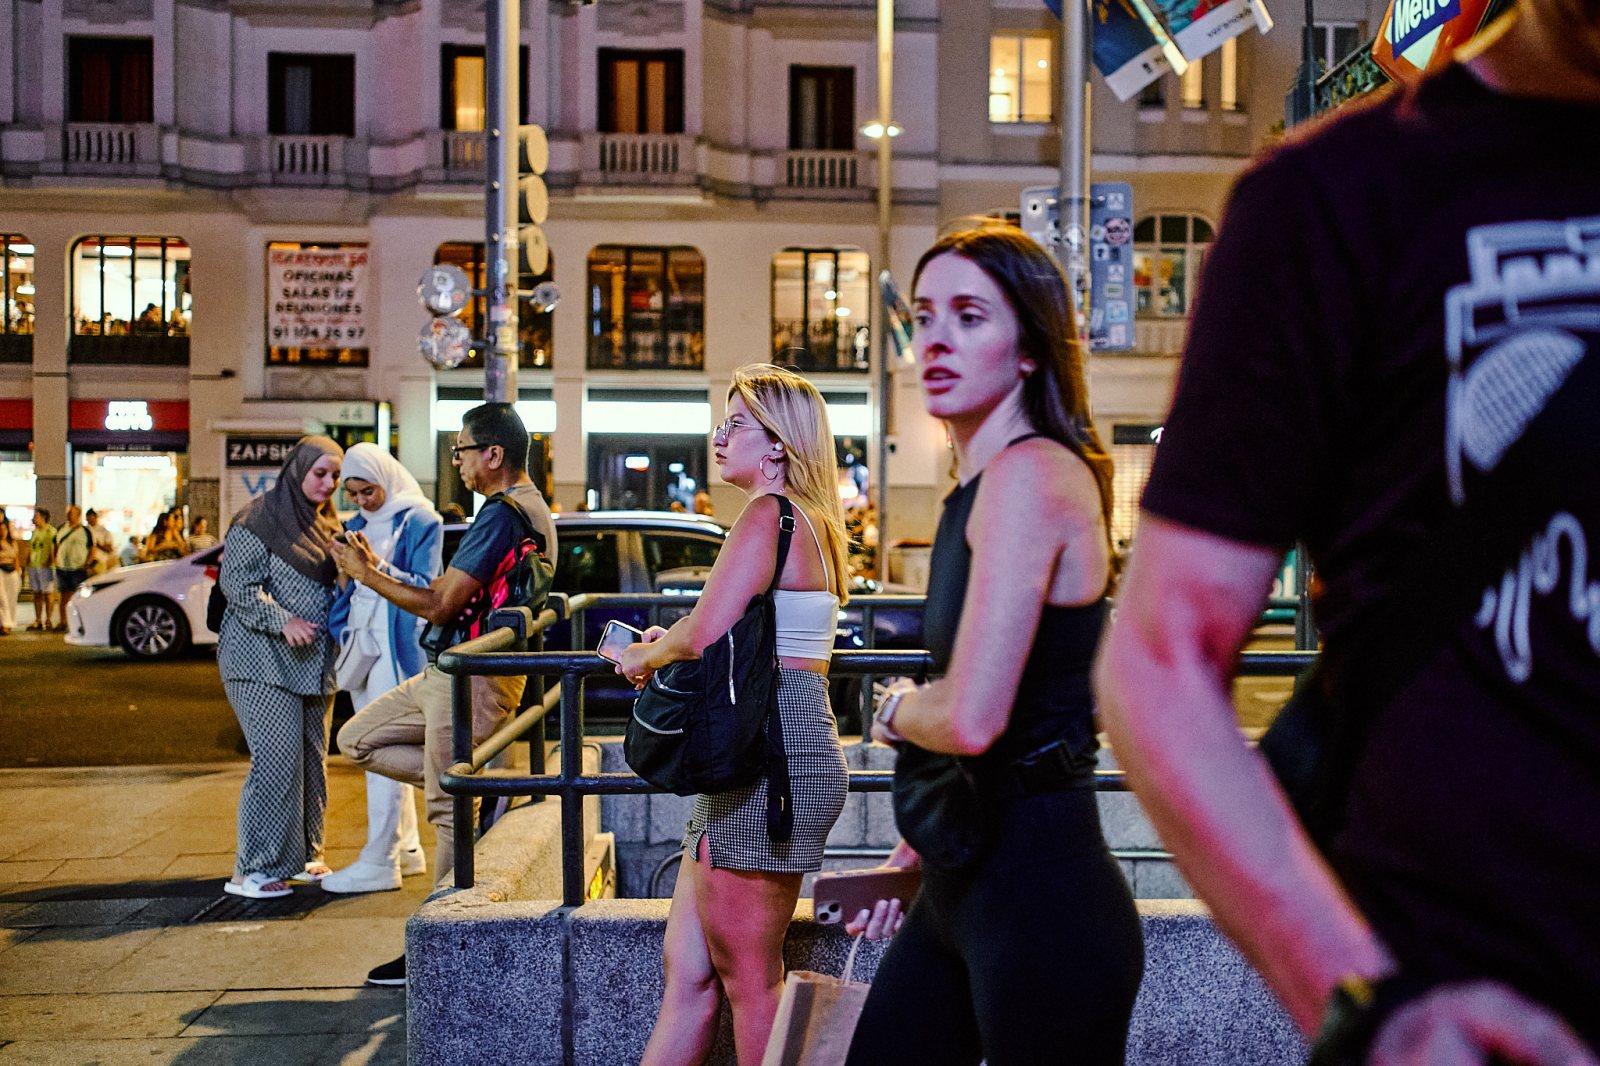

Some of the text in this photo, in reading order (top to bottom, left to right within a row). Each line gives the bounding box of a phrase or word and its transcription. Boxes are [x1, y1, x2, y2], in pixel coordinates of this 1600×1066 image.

[284, 269, 354, 282] OFICINAS
[282, 286, 354, 299] SALAS DE
[275, 302, 362, 315] REUNIONES
